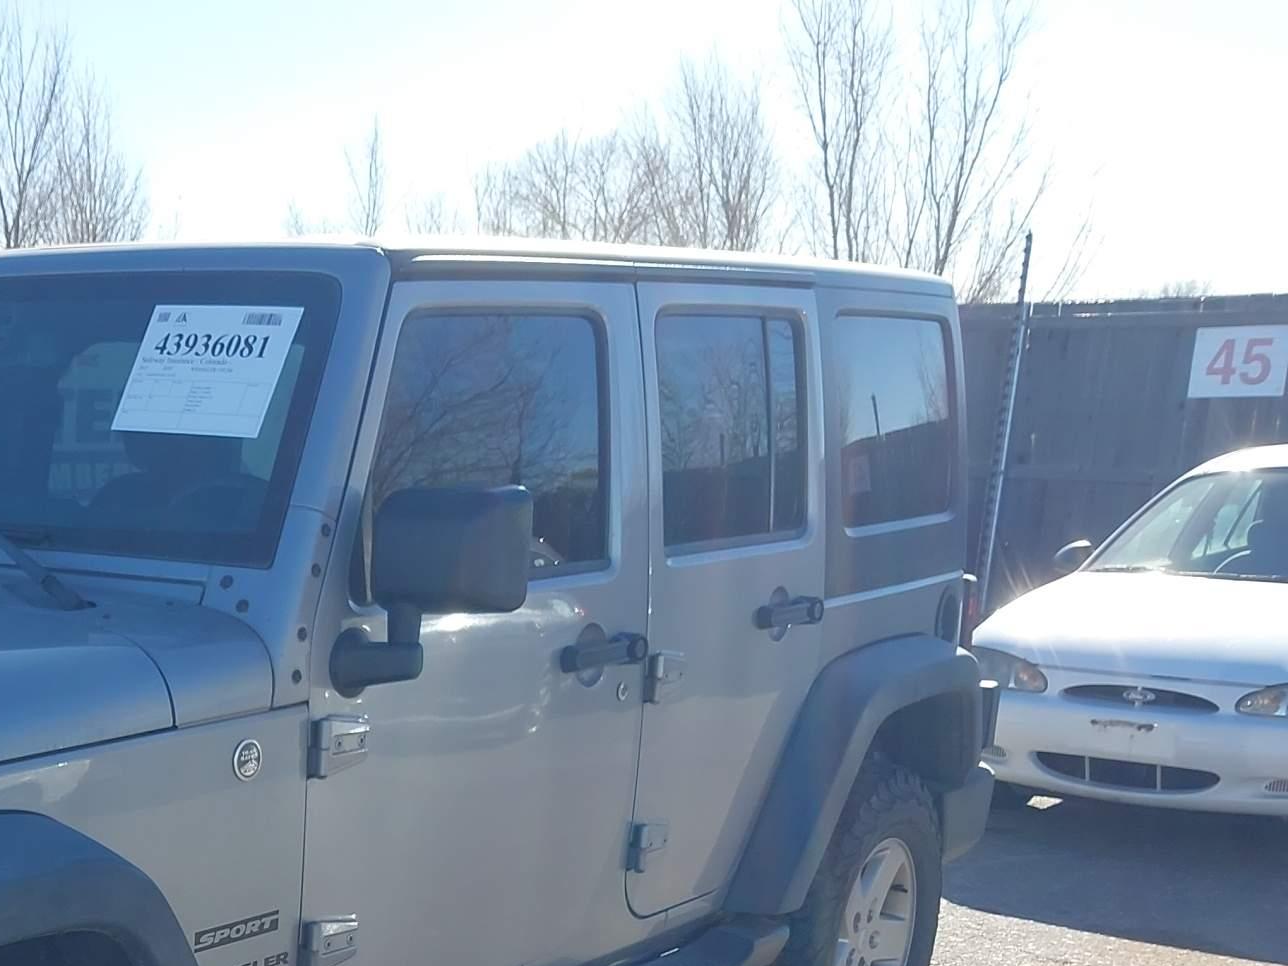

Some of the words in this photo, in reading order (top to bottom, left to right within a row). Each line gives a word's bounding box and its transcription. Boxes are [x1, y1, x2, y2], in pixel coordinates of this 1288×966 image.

[154, 332, 270, 359] 43936081
[1205, 337, 1274, 386] 45
[198, 916, 276, 949] SPORT
